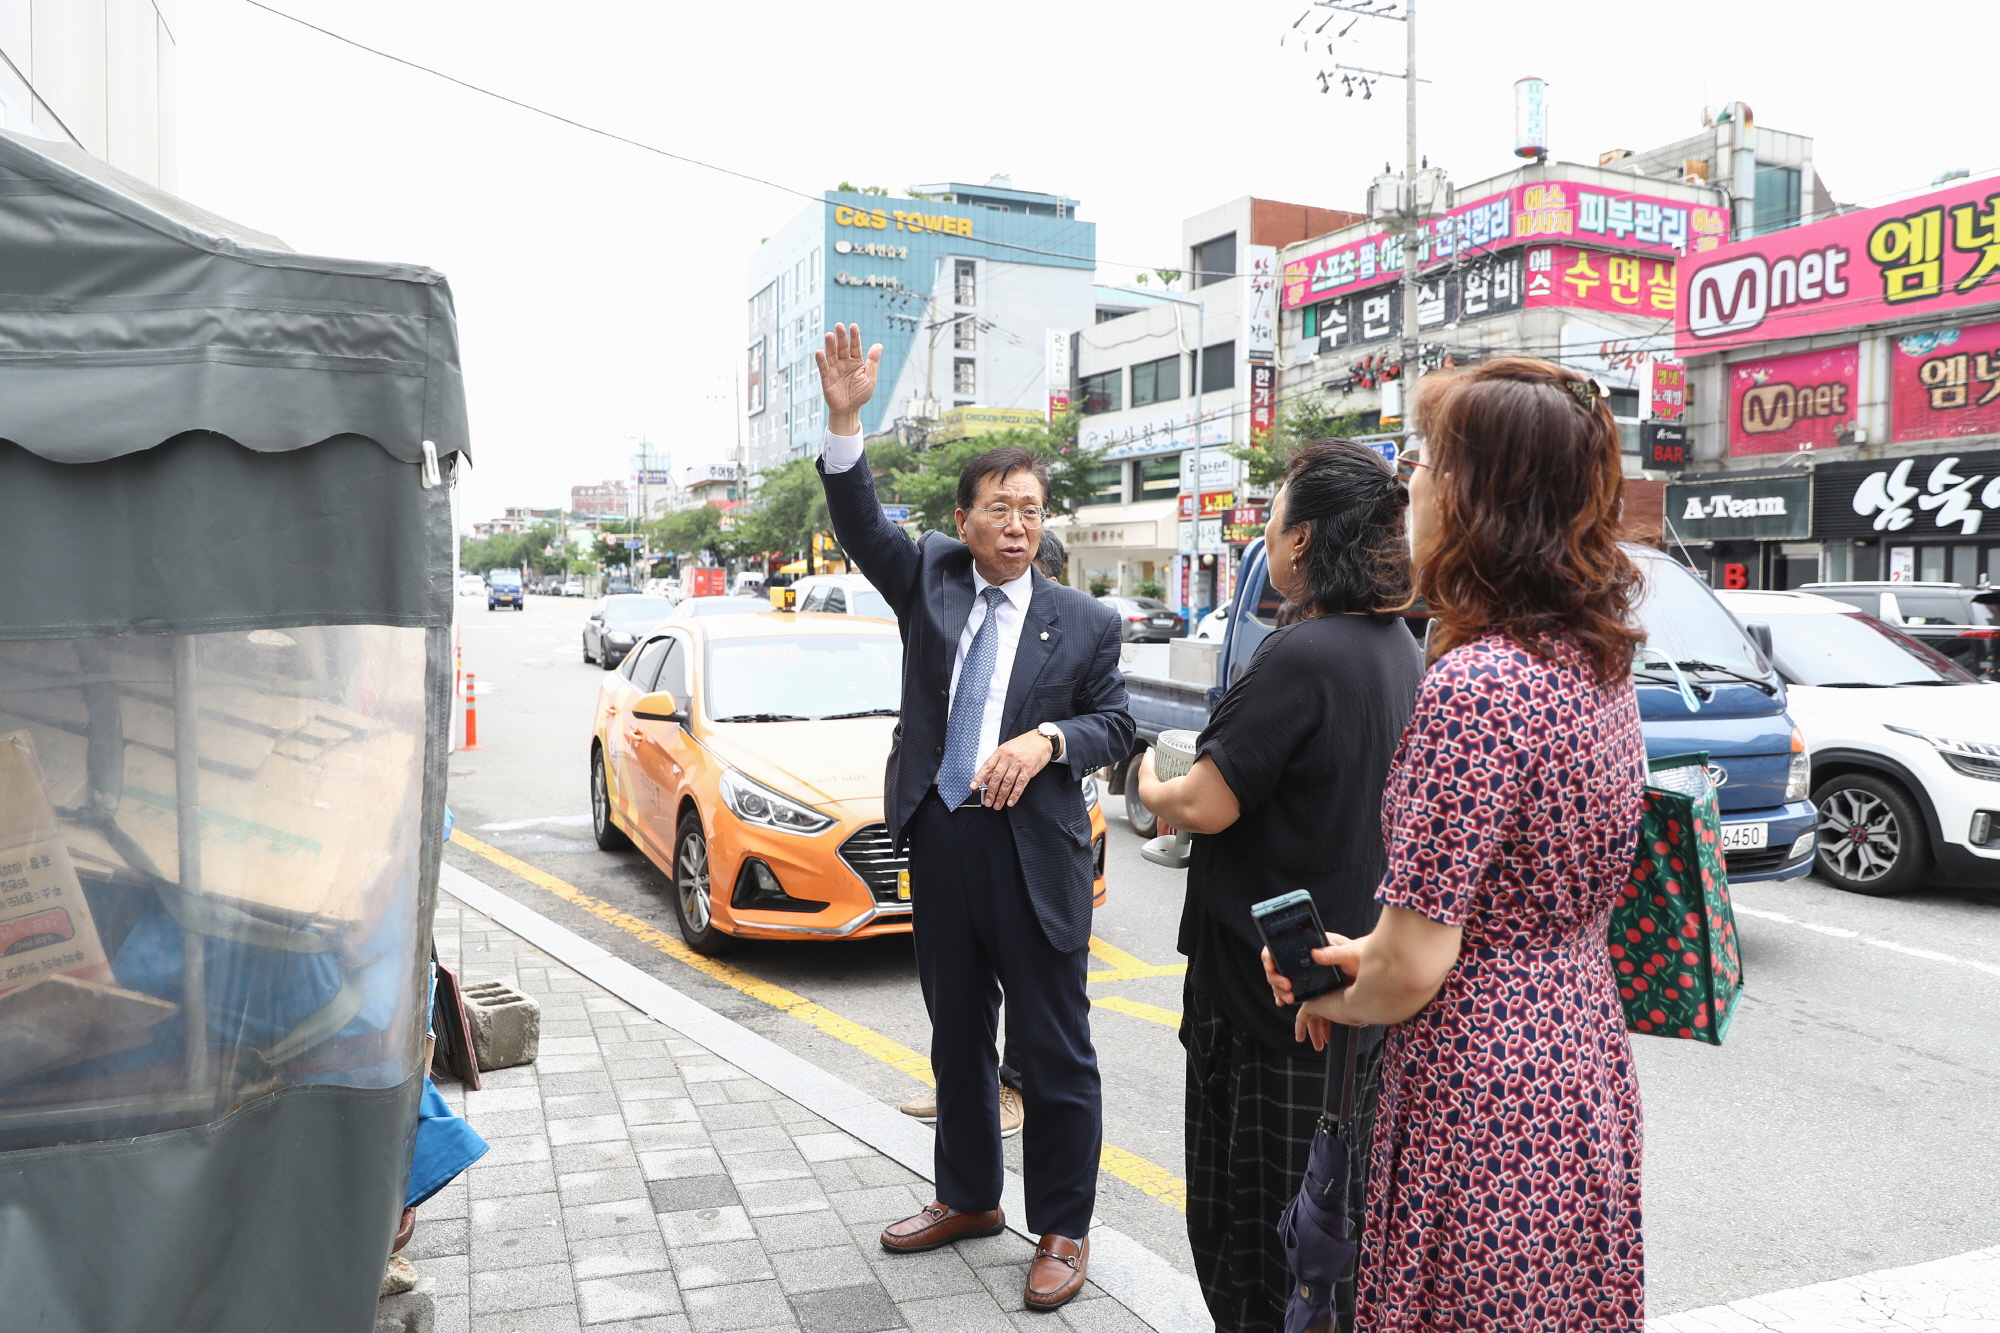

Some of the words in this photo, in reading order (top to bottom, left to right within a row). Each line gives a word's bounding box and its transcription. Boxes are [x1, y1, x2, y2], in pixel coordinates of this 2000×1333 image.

[1524, 186, 1566, 209] 에스
[835, 205, 888, 230] C&S
[892, 211, 973, 237] TOWER
[1516, 211, 1573, 237] 마사지
[1578, 191, 1688, 247] 피부관리
[1563, 251, 1677, 310] 수면실
[1653, 388, 1684, 407] 노래방
[1743, 382, 1847, 433] Mnet
[966, 413, 997, 423] CHICKEN
[1653, 445, 1685, 462] BAR
[1682, 495, 1788, 520] A-Team
[1724, 563, 1748, 590] B
[786, 592, 795, 603] T
[1722, 827, 1760, 847] 6450
